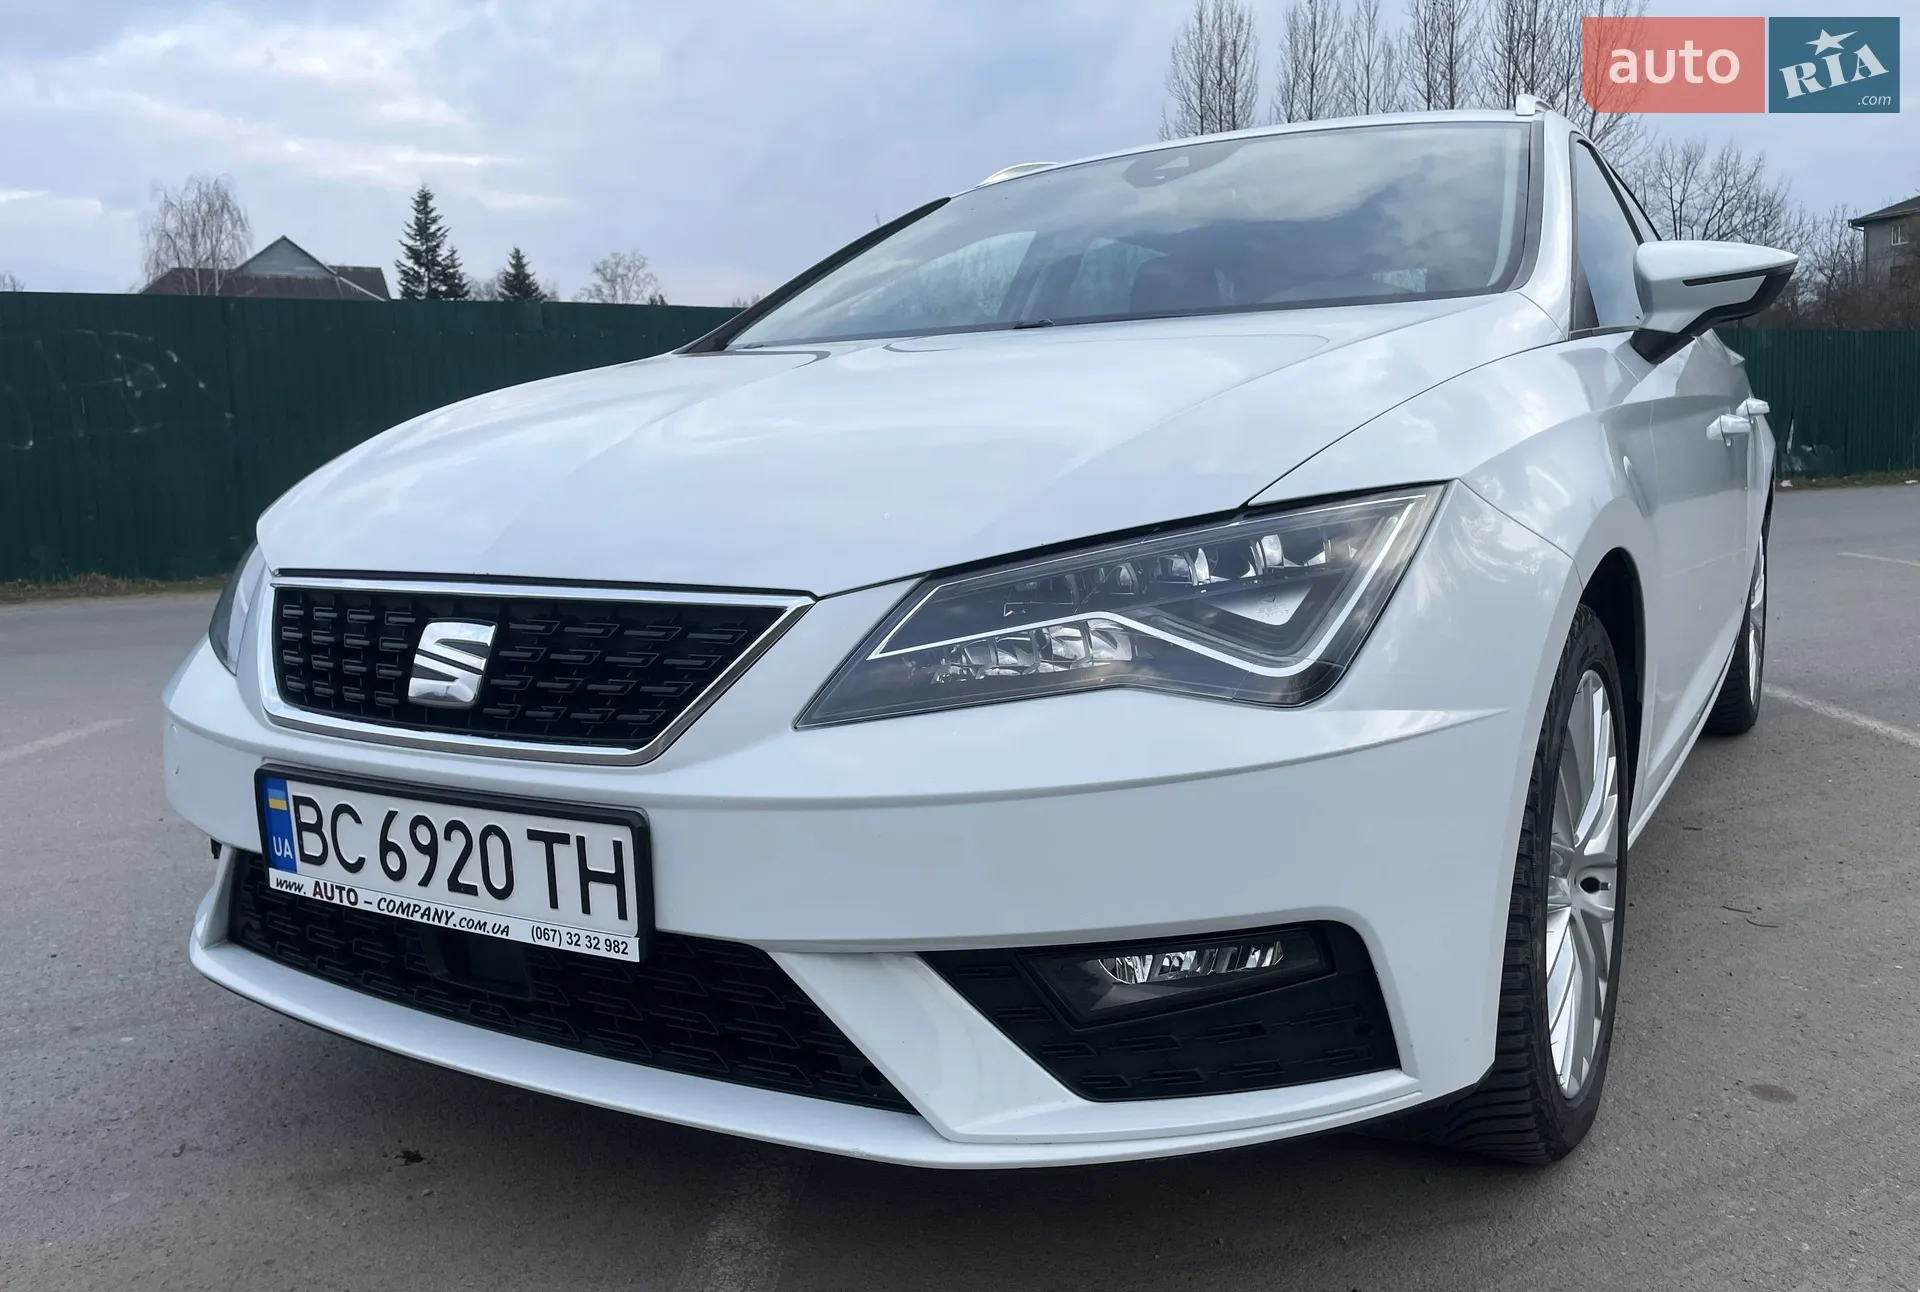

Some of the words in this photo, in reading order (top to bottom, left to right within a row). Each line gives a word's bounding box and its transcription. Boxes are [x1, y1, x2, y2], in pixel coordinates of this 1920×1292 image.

[273, 835, 293, 860] UA
[292, 794, 367, 874] BC
[379, 809, 515, 900] 6920
[526, 827, 628, 921] TH
[312, 880, 359, 907] AUTO
[531, 925, 562, 947] (067)
[566, 931, 582, 947] 32
[585, 935, 601, 950] 32
[604, 938, 629, 955] 982
